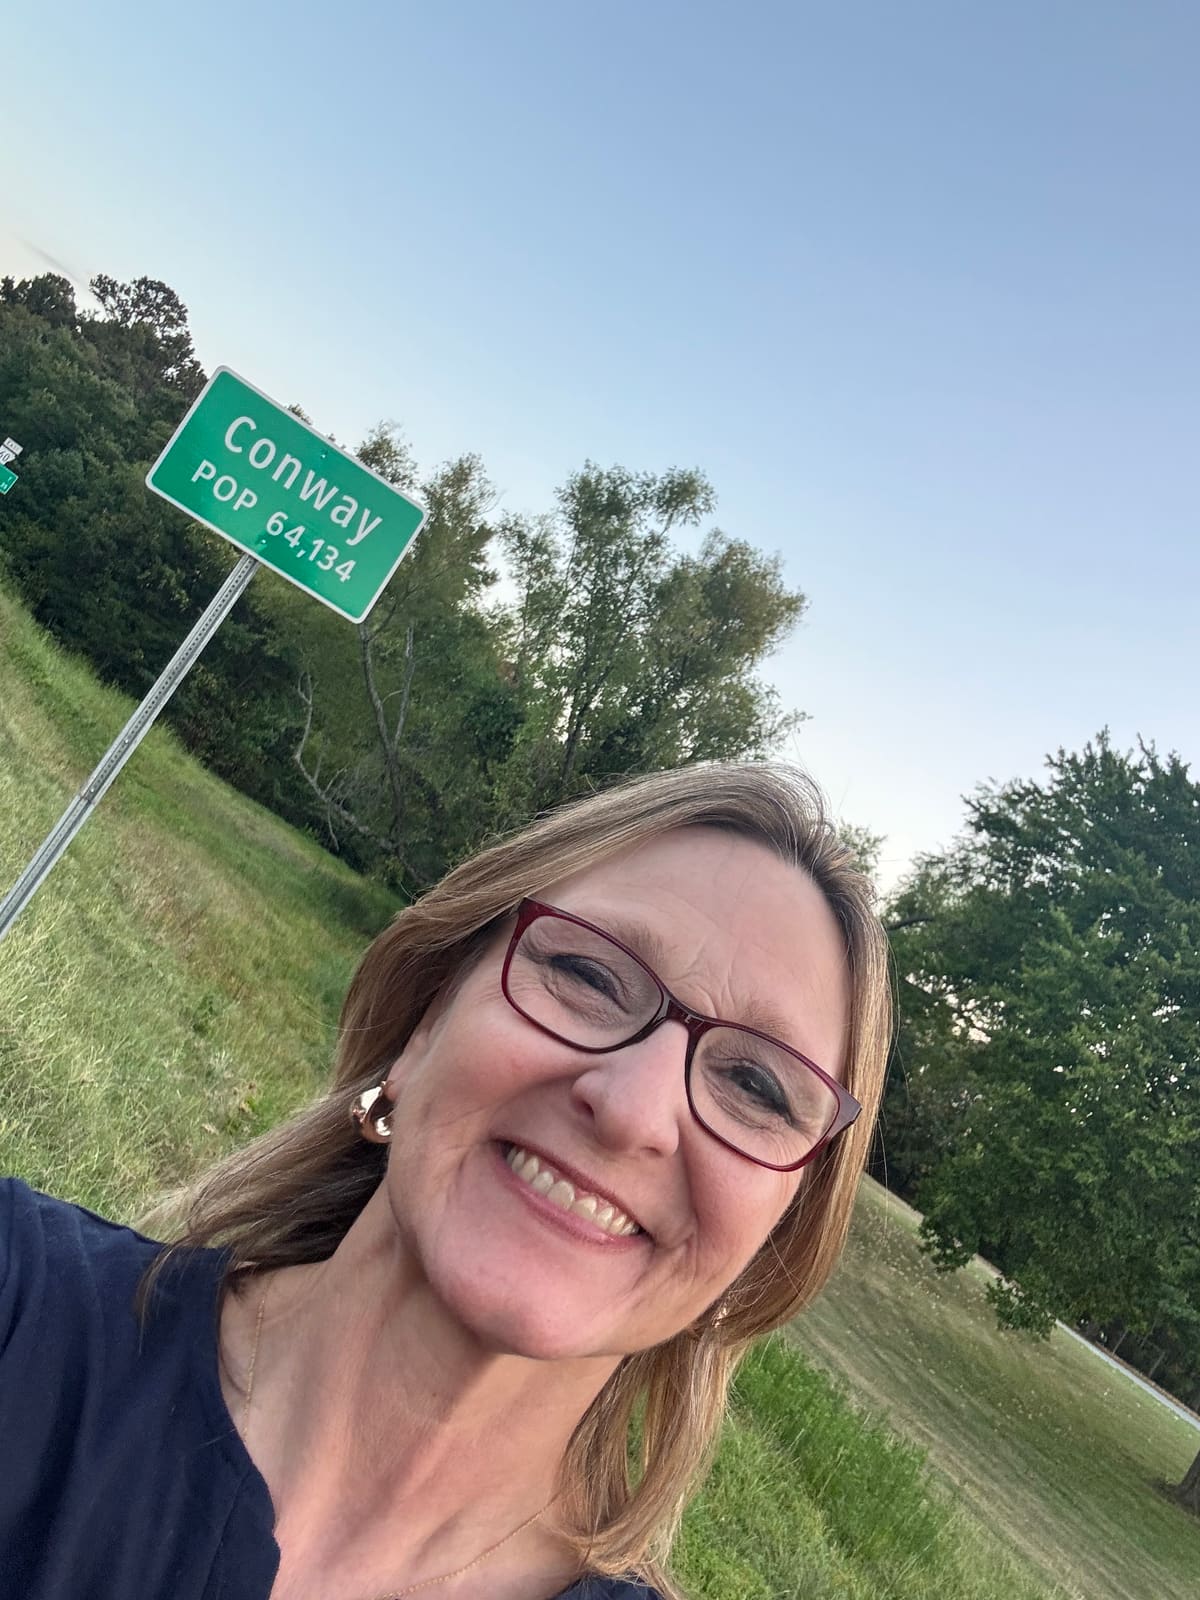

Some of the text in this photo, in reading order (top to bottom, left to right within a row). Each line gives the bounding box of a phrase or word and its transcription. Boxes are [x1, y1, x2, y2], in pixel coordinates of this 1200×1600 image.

[191, 460, 357, 582] POP 64,134
[224, 416, 383, 546] Conway
